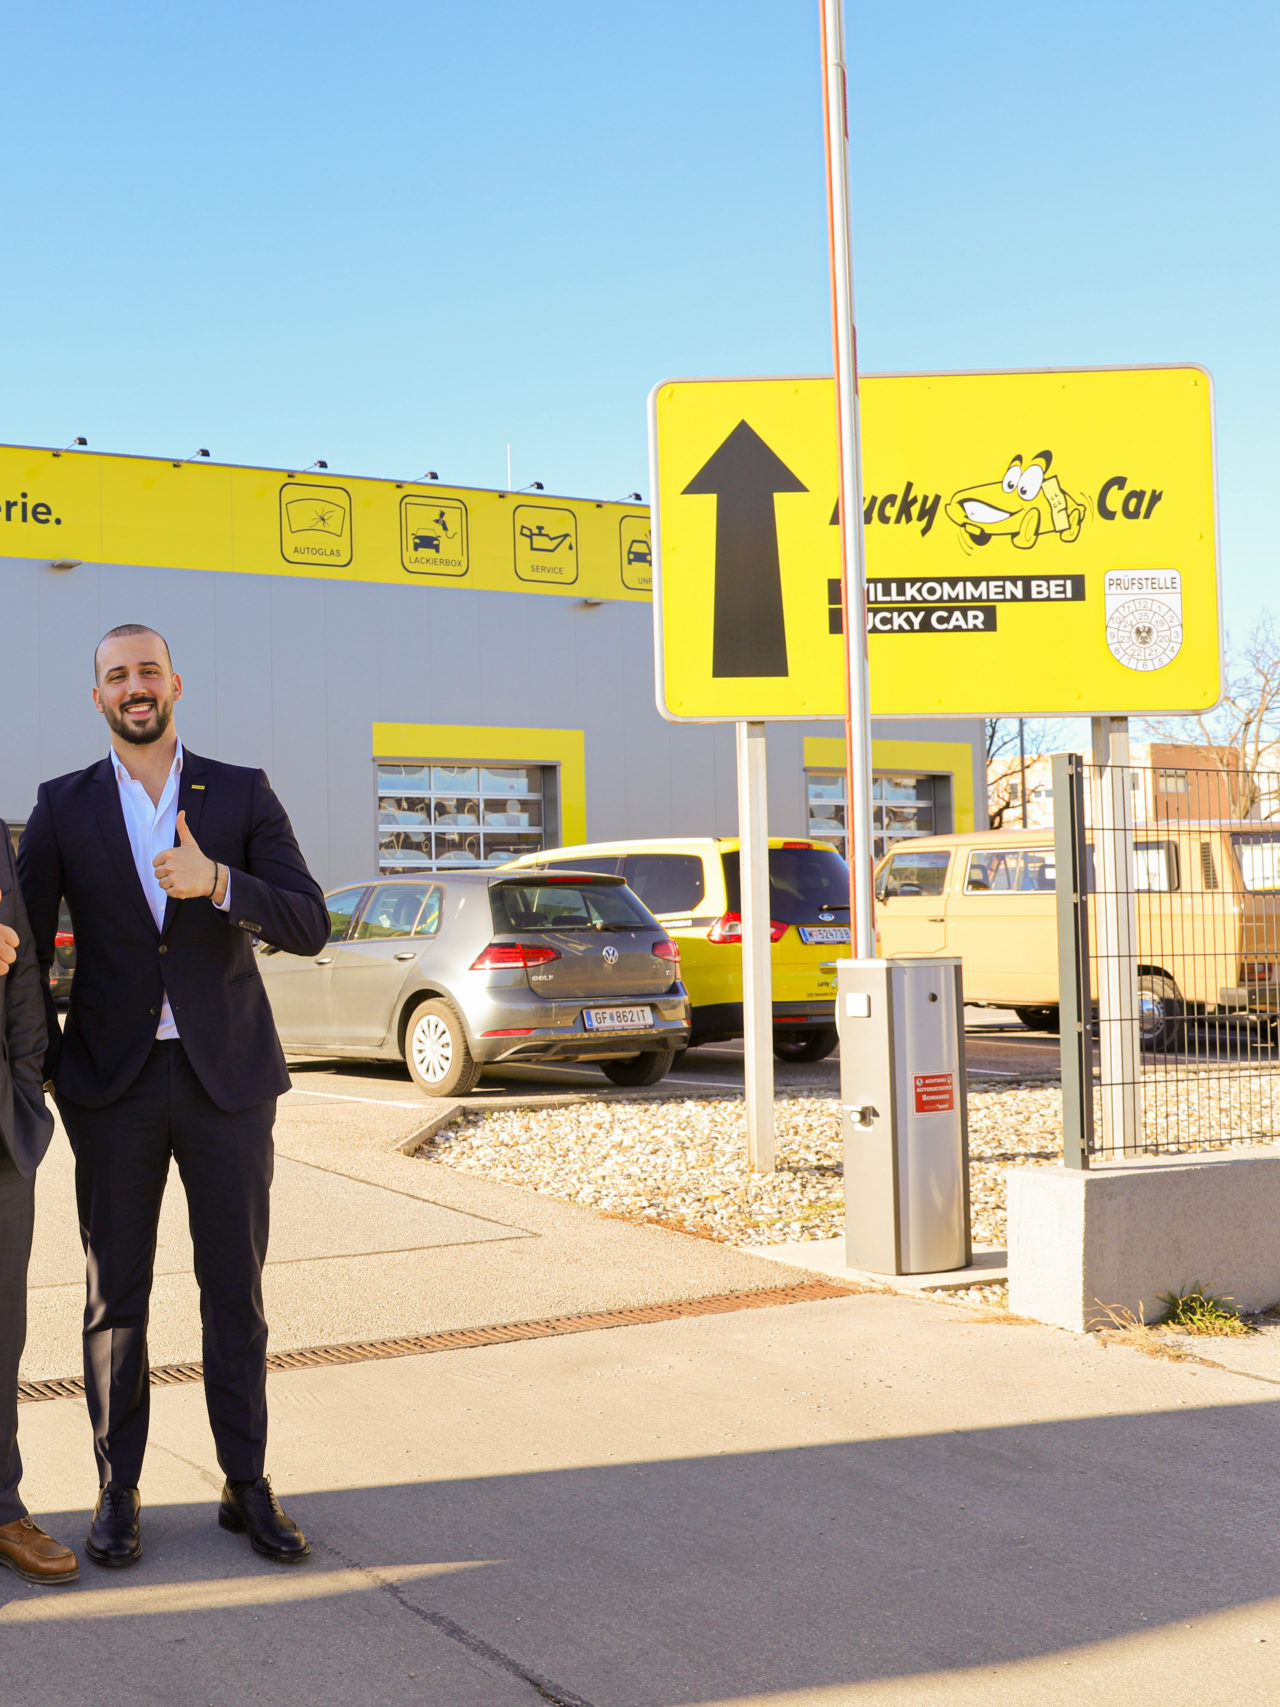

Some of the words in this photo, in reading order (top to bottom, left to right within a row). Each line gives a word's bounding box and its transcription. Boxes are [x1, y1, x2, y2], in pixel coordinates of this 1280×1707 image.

[1096, 475, 1163, 520] Car
[292, 545, 342, 558] AUTOGLAS
[408, 555, 463, 568] LACKIERBOX
[530, 564, 564, 576] SERVICE
[637, 576, 653, 585] UNF
[1108, 574, 1178, 591] PRÜFSTELLE
[840, 580, 1024, 602] ILLKOMMEN
[1030, 579, 1073, 600] BEI
[1138, 601, 1148, 609] 12
[866, 611, 926, 631] CKY
[930, 610, 985, 630] CAR
[1138, 612, 1150, 621] 25
[1168, 615, 1175, 623] 2
[1123, 620, 1133, 628] 24
[1155, 619, 1165, 627] 19
[1159, 634, 1170, 643] 20
[1174, 630, 1179, 638] 3
[1114, 646, 1120, 655] 8
[1131, 648, 1142, 657] 22
[1148, 648, 1158, 657] 21
[1142, 661, 1148, 670] 6
[531, 974, 555, 982] GOLF
[594, 1011, 608, 1025] GF
